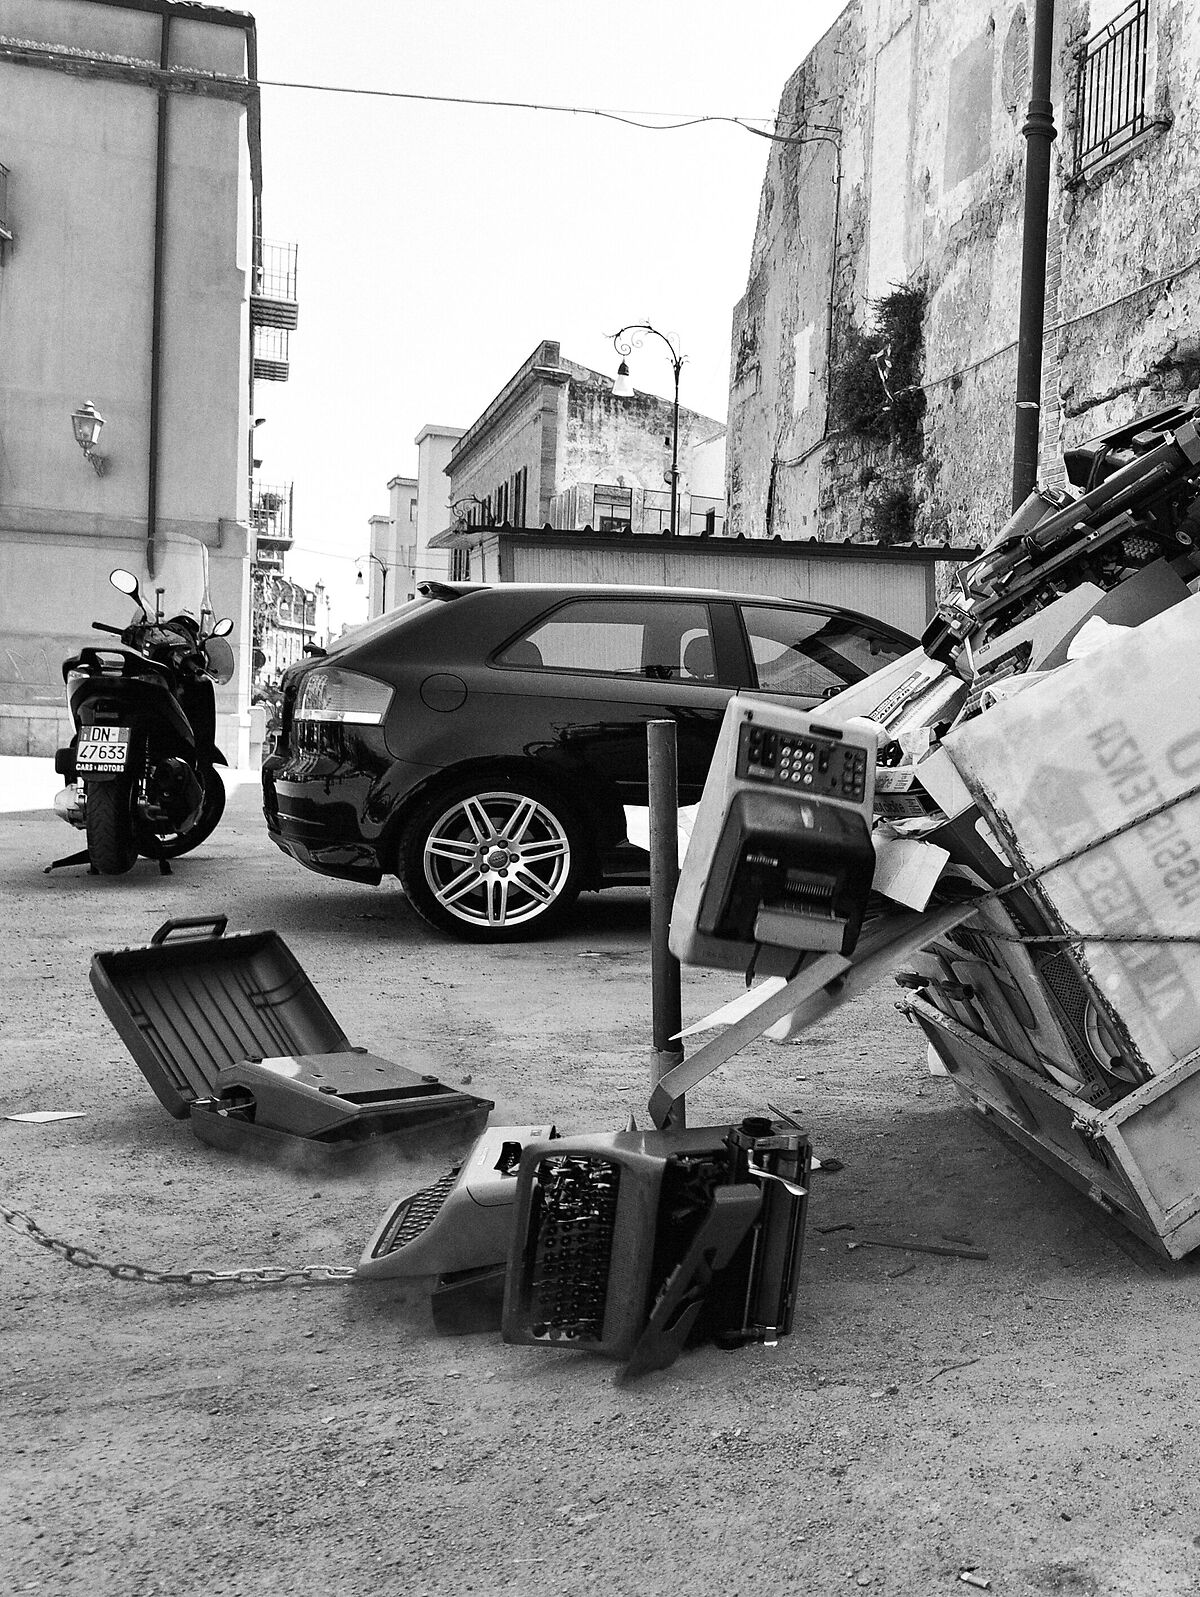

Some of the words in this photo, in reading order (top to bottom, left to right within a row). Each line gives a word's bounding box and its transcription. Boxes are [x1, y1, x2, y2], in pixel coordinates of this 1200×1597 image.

[92, 728, 111, 741] DN
[79, 745, 126, 760] 47633
[75, 763, 94, 771] CARS
[97, 764, 125, 773] MOTORS
